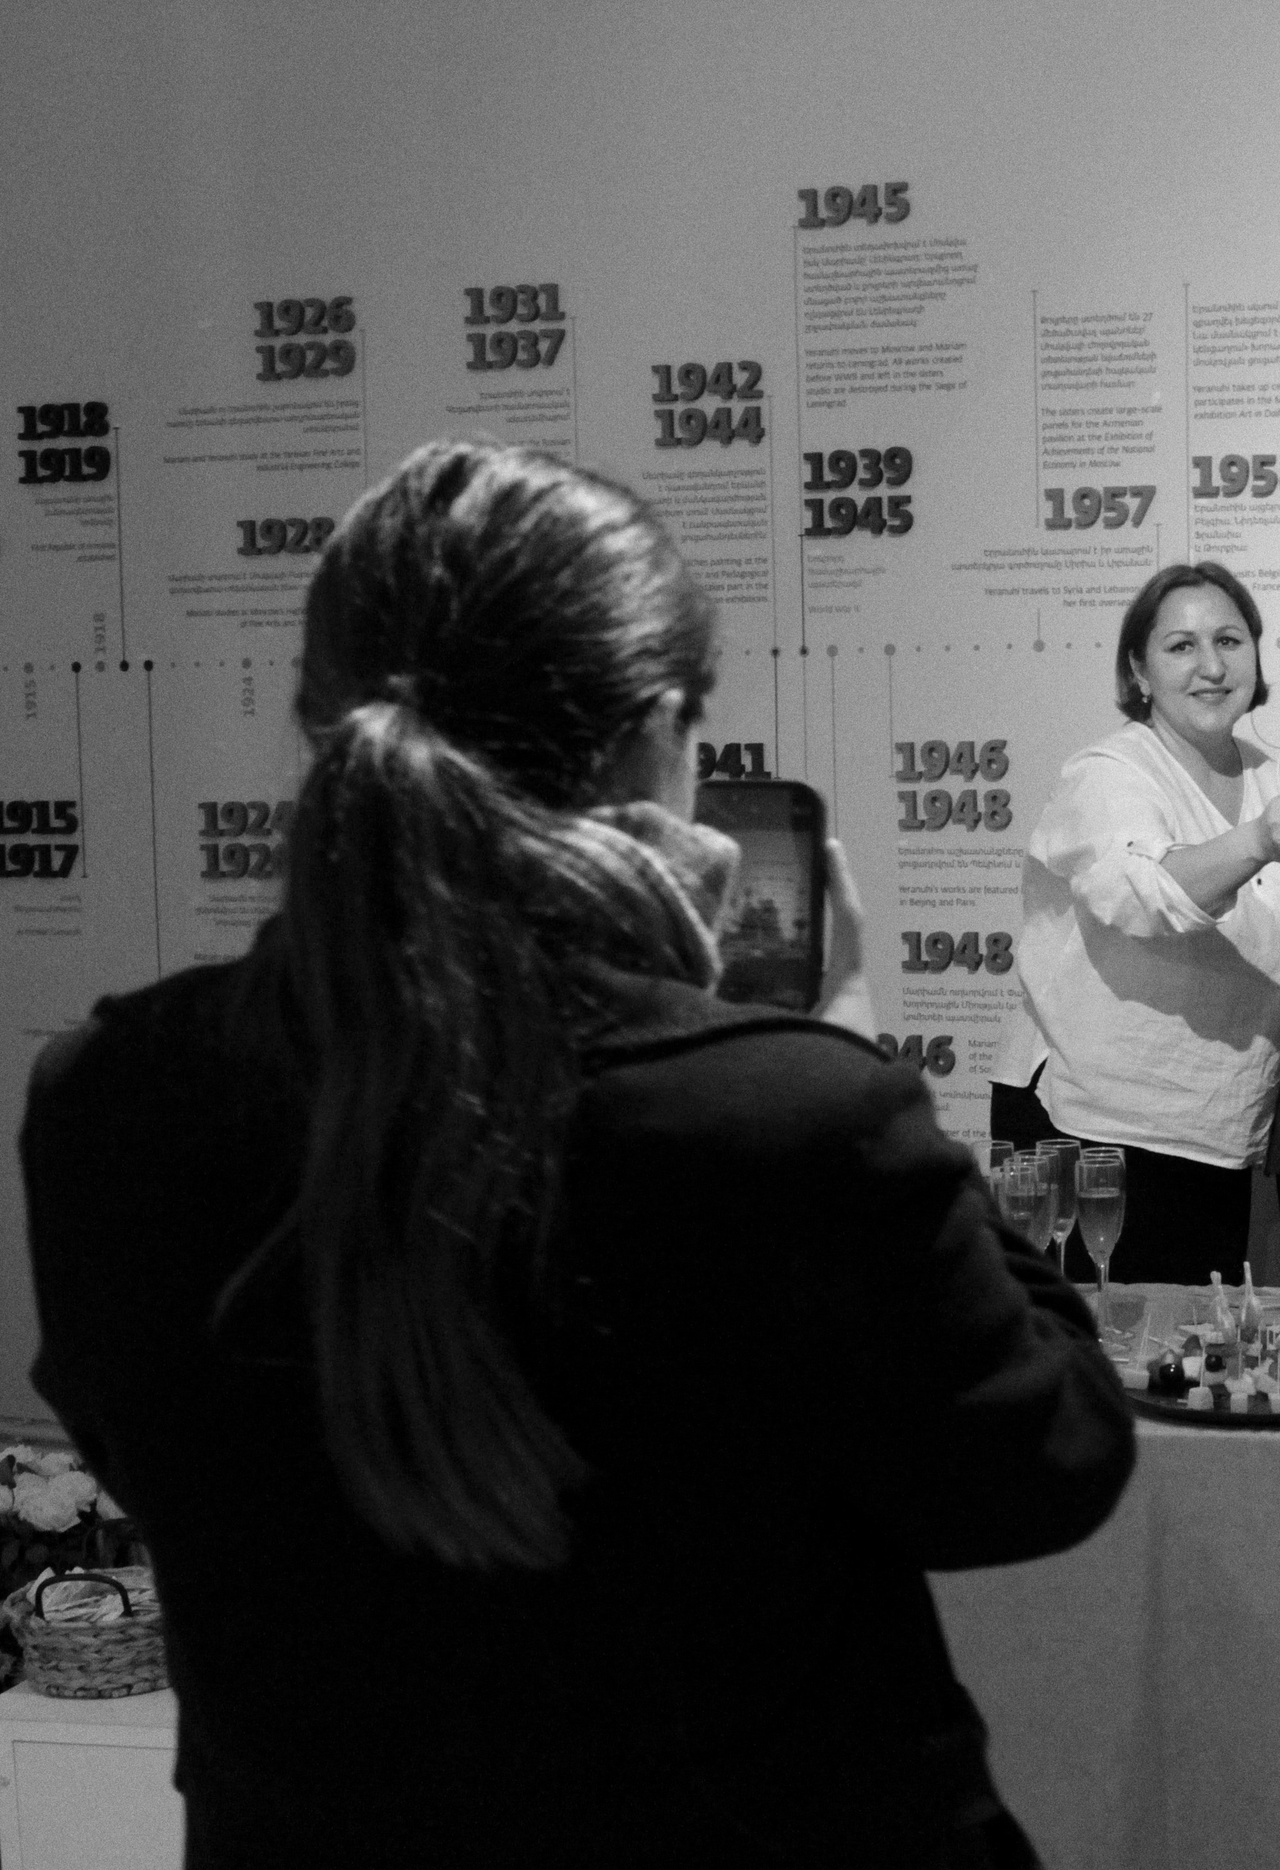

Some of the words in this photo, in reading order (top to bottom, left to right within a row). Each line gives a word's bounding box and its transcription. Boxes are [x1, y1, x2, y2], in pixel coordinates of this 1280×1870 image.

[798, 181, 911, 230] 1945
[254, 296, 356, 337] 1926
[464, 283, 566, 325] 1931
[255, 340, 356, 381] 1929
[466, 329, 566, 371] 1937
[652, 361, 764, 402] 1942
[17, 402, 109, 441] 1918
[654, 406, 766, 447] 1944
[18, 446, 110, 484] 1919
[803, 446, 913, 491] 1939
[804, 495, 914, 538] 1945
[1044, 485, 1157, 531] 1957
[697, 742, 771, 779] 941
[895, 739, 1010, 783] 1946
[897, 789, 1013, 832] 1948
[200, 844, 288, 879] 192
[901, 931, 1014, 975] 1948
[878, 1033, 956, 1078] 946
